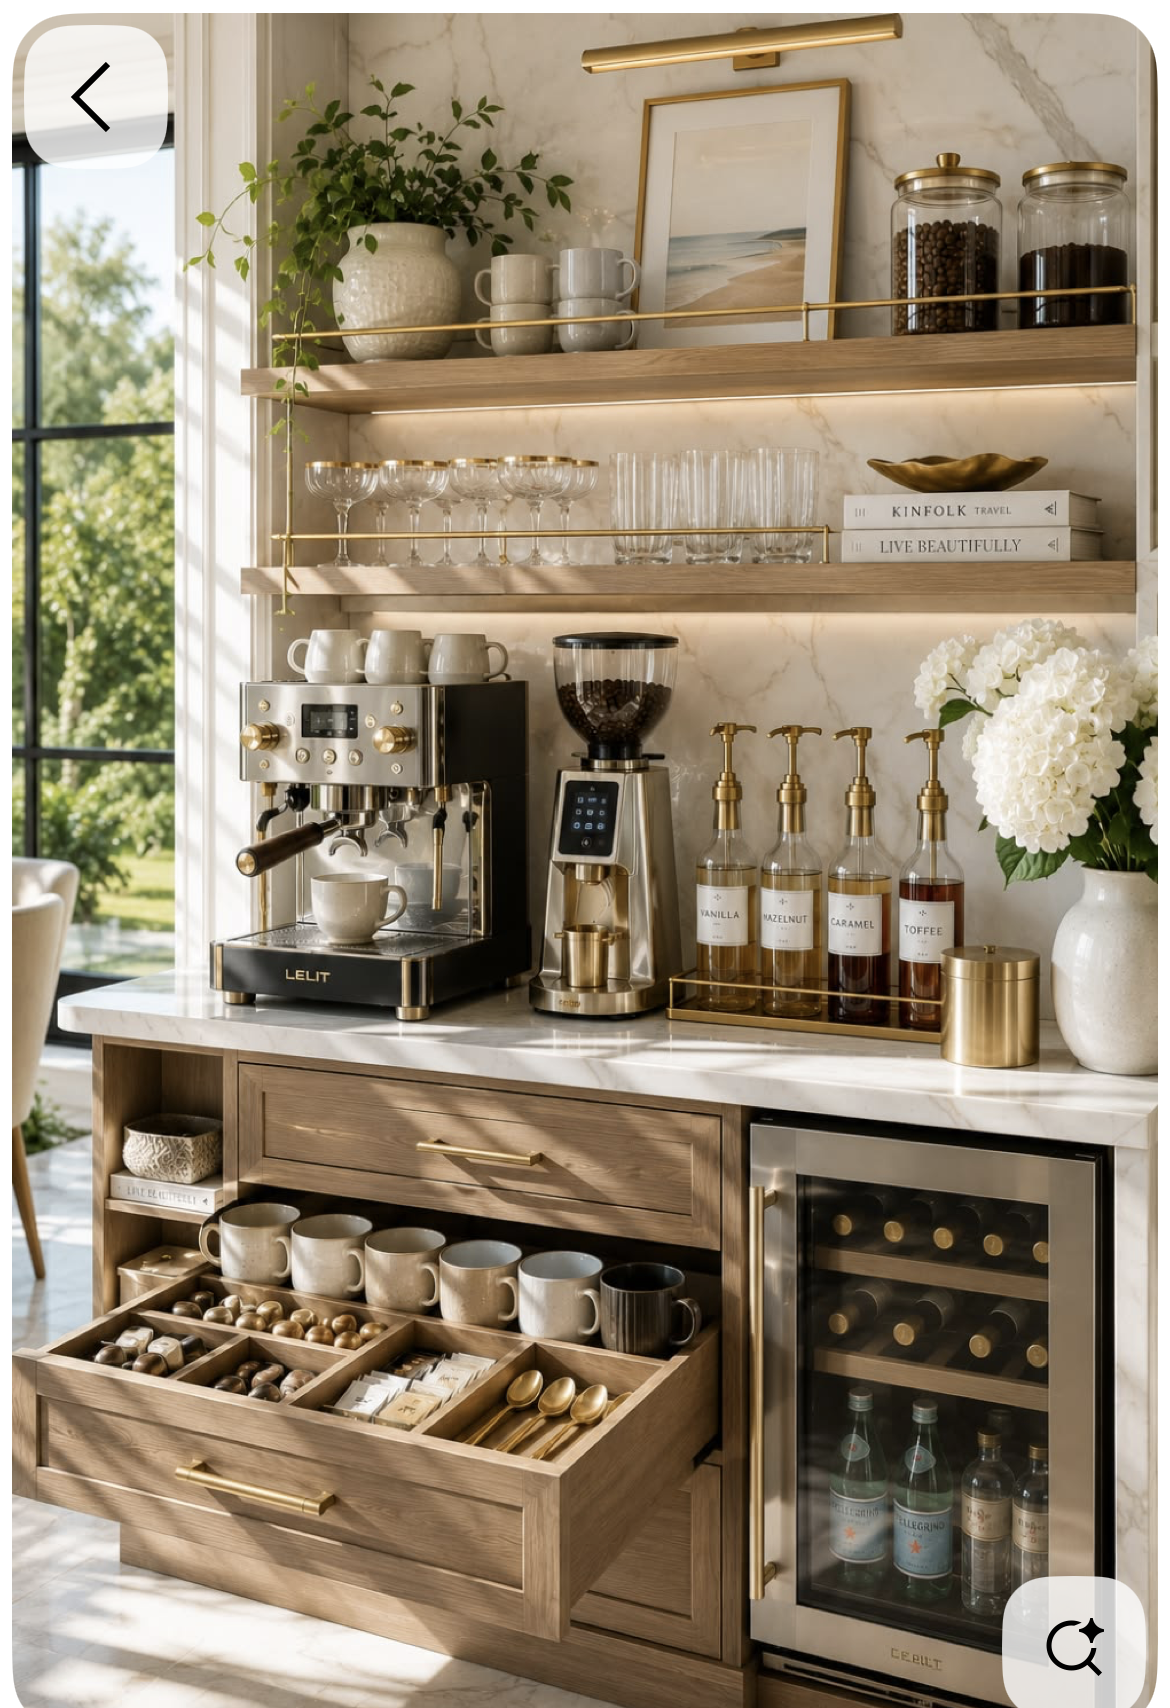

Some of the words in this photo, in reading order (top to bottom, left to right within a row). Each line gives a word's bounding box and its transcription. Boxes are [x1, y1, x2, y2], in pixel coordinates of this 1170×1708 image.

[891, 504, 967, 518] KINFOLK
[974, 506, 1012, 515] TRAVEL
[880, 540, 913, 554] LIVE
[918, 538, 1022, 553] BEAUTIFULLY
[700, 909, 740, 919] VANILLA
[763, 913, 808, 924] HAZELNUT
[830, 917, 875, 930] CARAMEL
[904, 924, 943, 936] TOFFEE
[285, 968, 331, 983] LELIT
